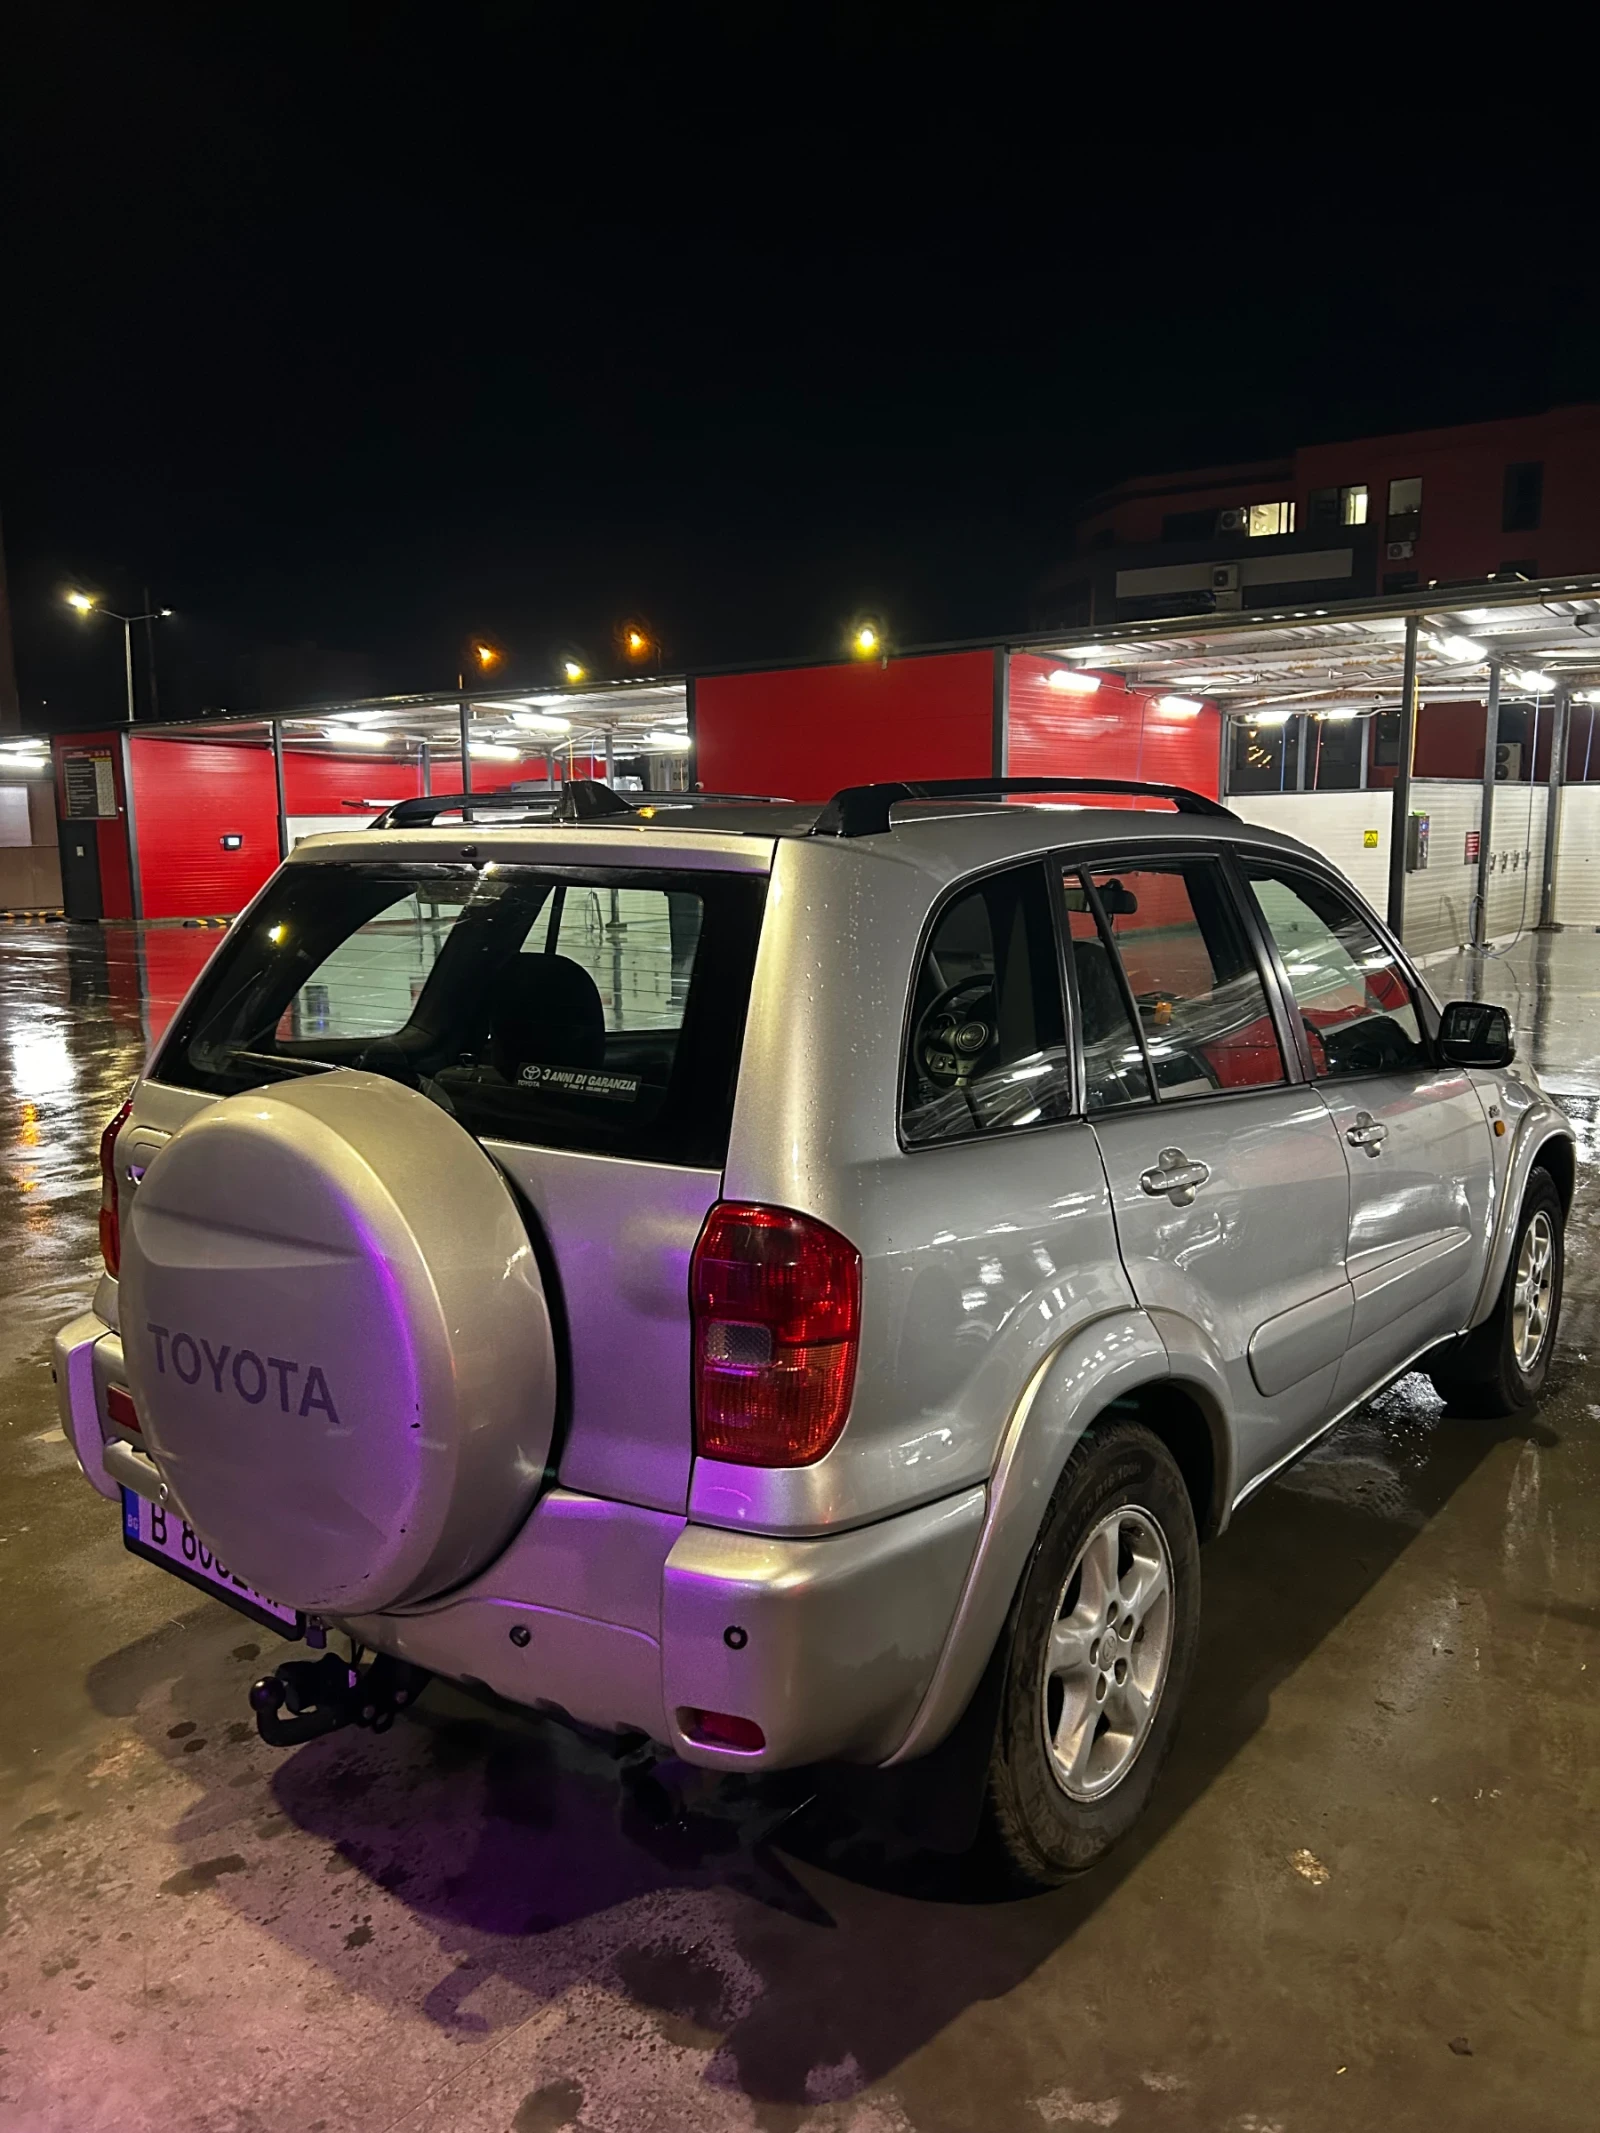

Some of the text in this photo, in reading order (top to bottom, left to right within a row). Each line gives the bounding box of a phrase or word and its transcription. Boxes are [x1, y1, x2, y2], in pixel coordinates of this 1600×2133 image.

[517, 1079, 540, 1089] TOYOTA
[542, 1068, 637, 1091] 3 ANNI DI GARANZIA
[147, 1322, 340, 1424] TOYOTA
[127, 1513, 139, 1531] BG
[151, 1502, 249, 1591] B 80
